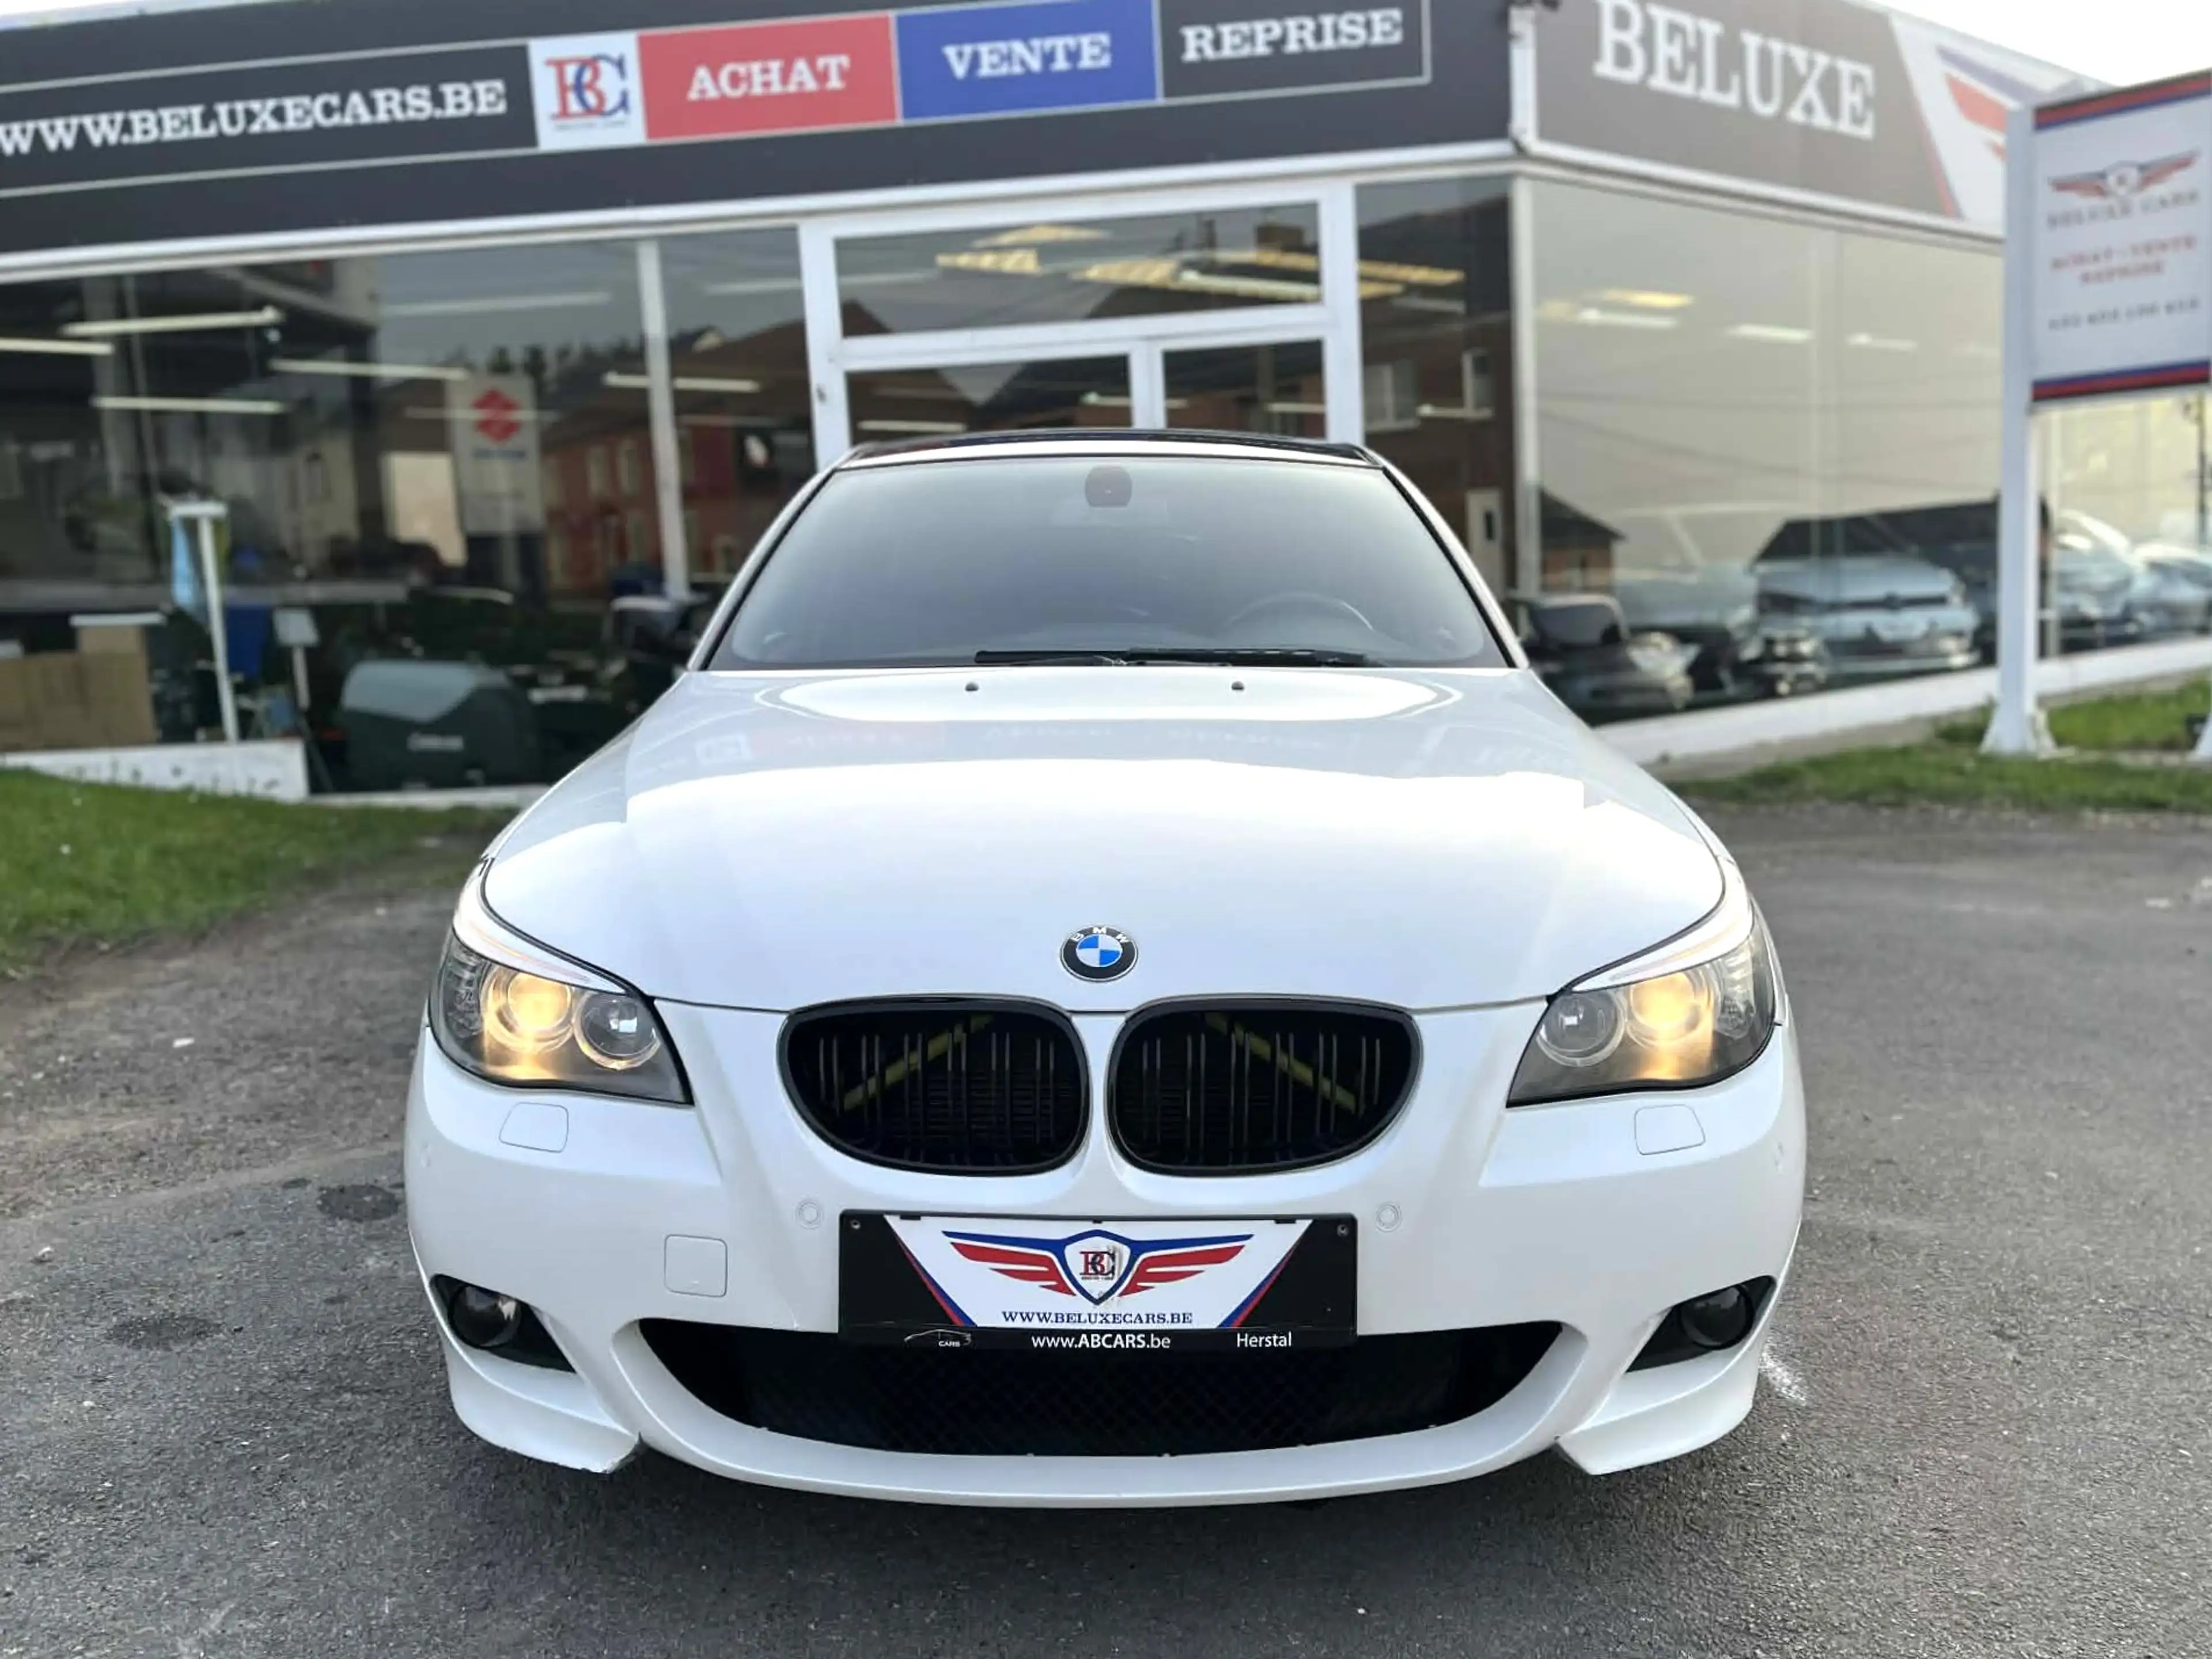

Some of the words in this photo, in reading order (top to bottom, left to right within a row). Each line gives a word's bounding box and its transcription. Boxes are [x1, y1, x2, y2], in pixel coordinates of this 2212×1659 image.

[942, 33, 1111, 80] VENTE
[1180, 9, 1403, 62] REPRISE
[687, 55, 850, 101] ACHAT
[1593, 0, 1876, 141] BELUXE
[0, 79, 507, 156] WWW.BELUXECARS.BE
[1070, 927, 1130, 942] BMW
[1002, 1311, 1193, 1324] WWW.BELUXECARS.BE
[1237, 1330, 1292, 1347] Herstal
[1032, 1333, 1171, 1349] www.ABCARS.be
